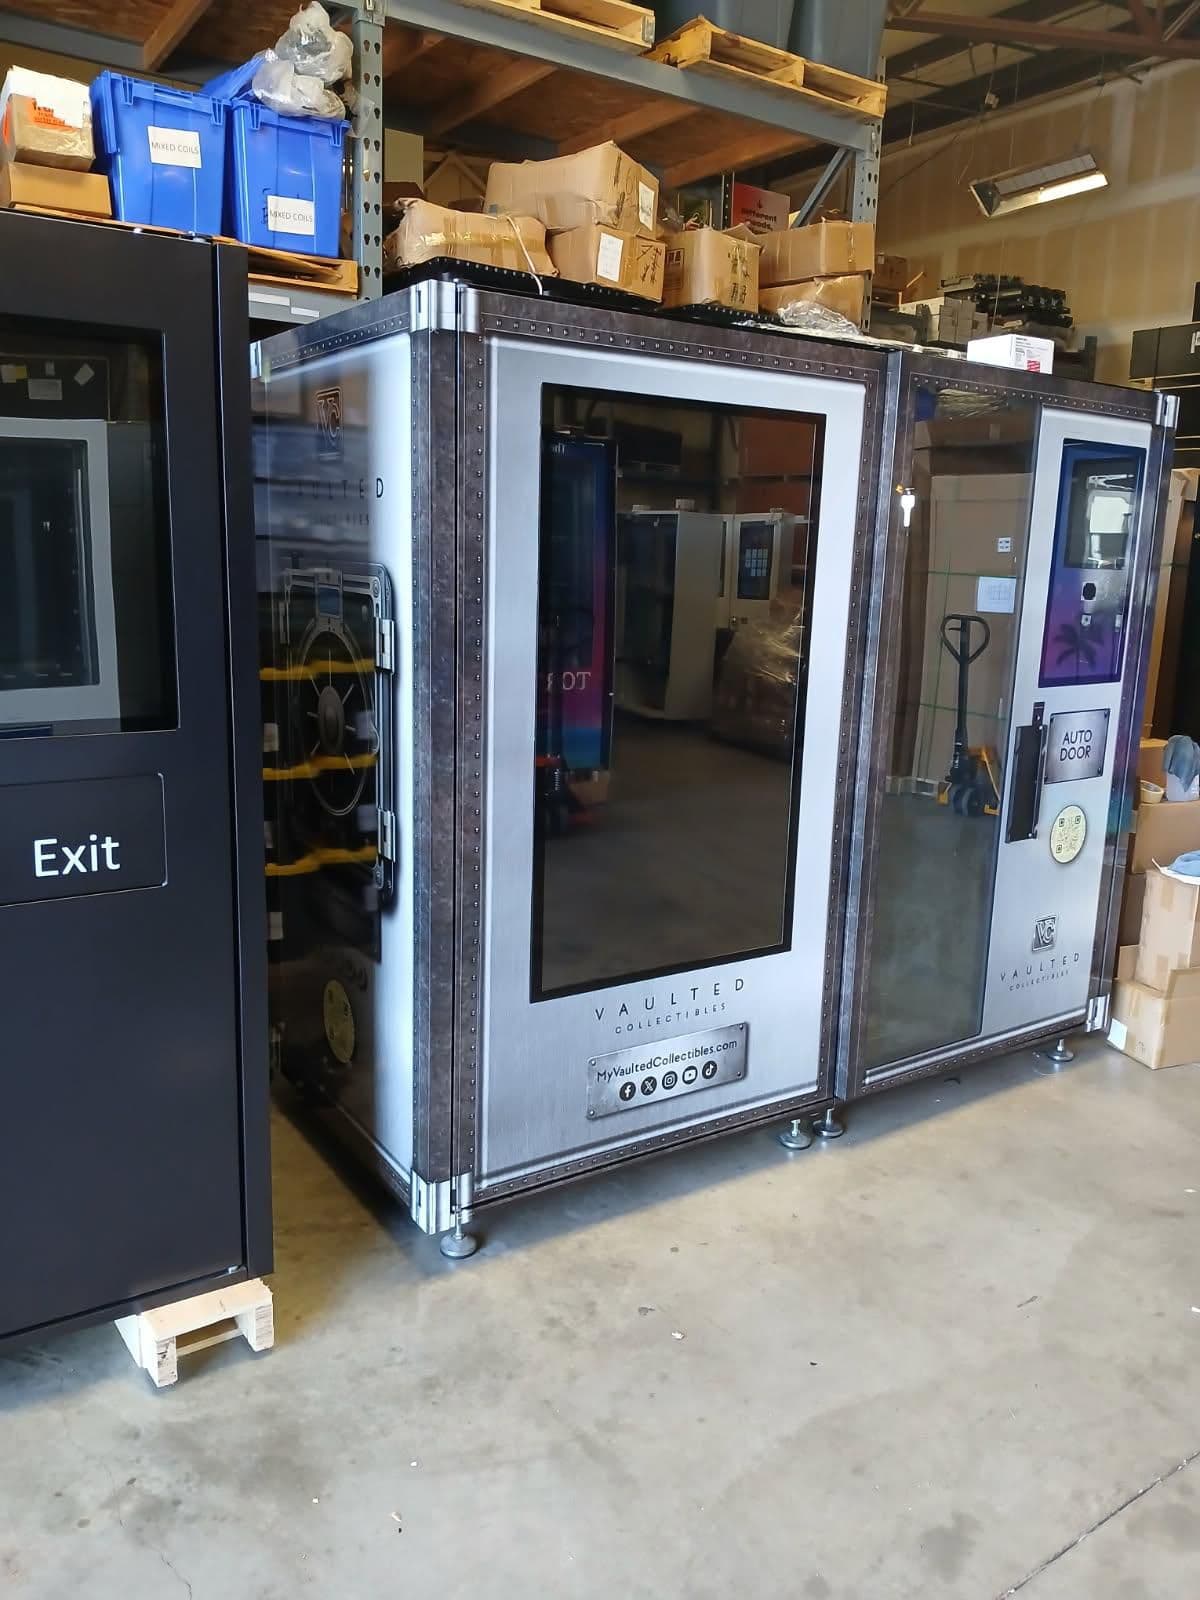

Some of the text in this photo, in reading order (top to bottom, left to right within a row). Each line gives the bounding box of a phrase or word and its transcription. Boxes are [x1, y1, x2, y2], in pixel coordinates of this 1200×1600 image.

[151, 141, 199, 155] MIXED COILS
[269, 209, 313, 223] MIXED COILS
[1062, 729, 1093, 745] AUTO
[1060, 745, 1091, 761] DOOR
[34, 834, 121, 877] Exit
[1000, 953, 1080, 981] VAULTED
[595, 978, 744, 1020] VAULTED
[615, 1002, 726, 1034] COLLECTIBLES
[596, 1040, 738, 1083] MyVaultedCollectibles.com
